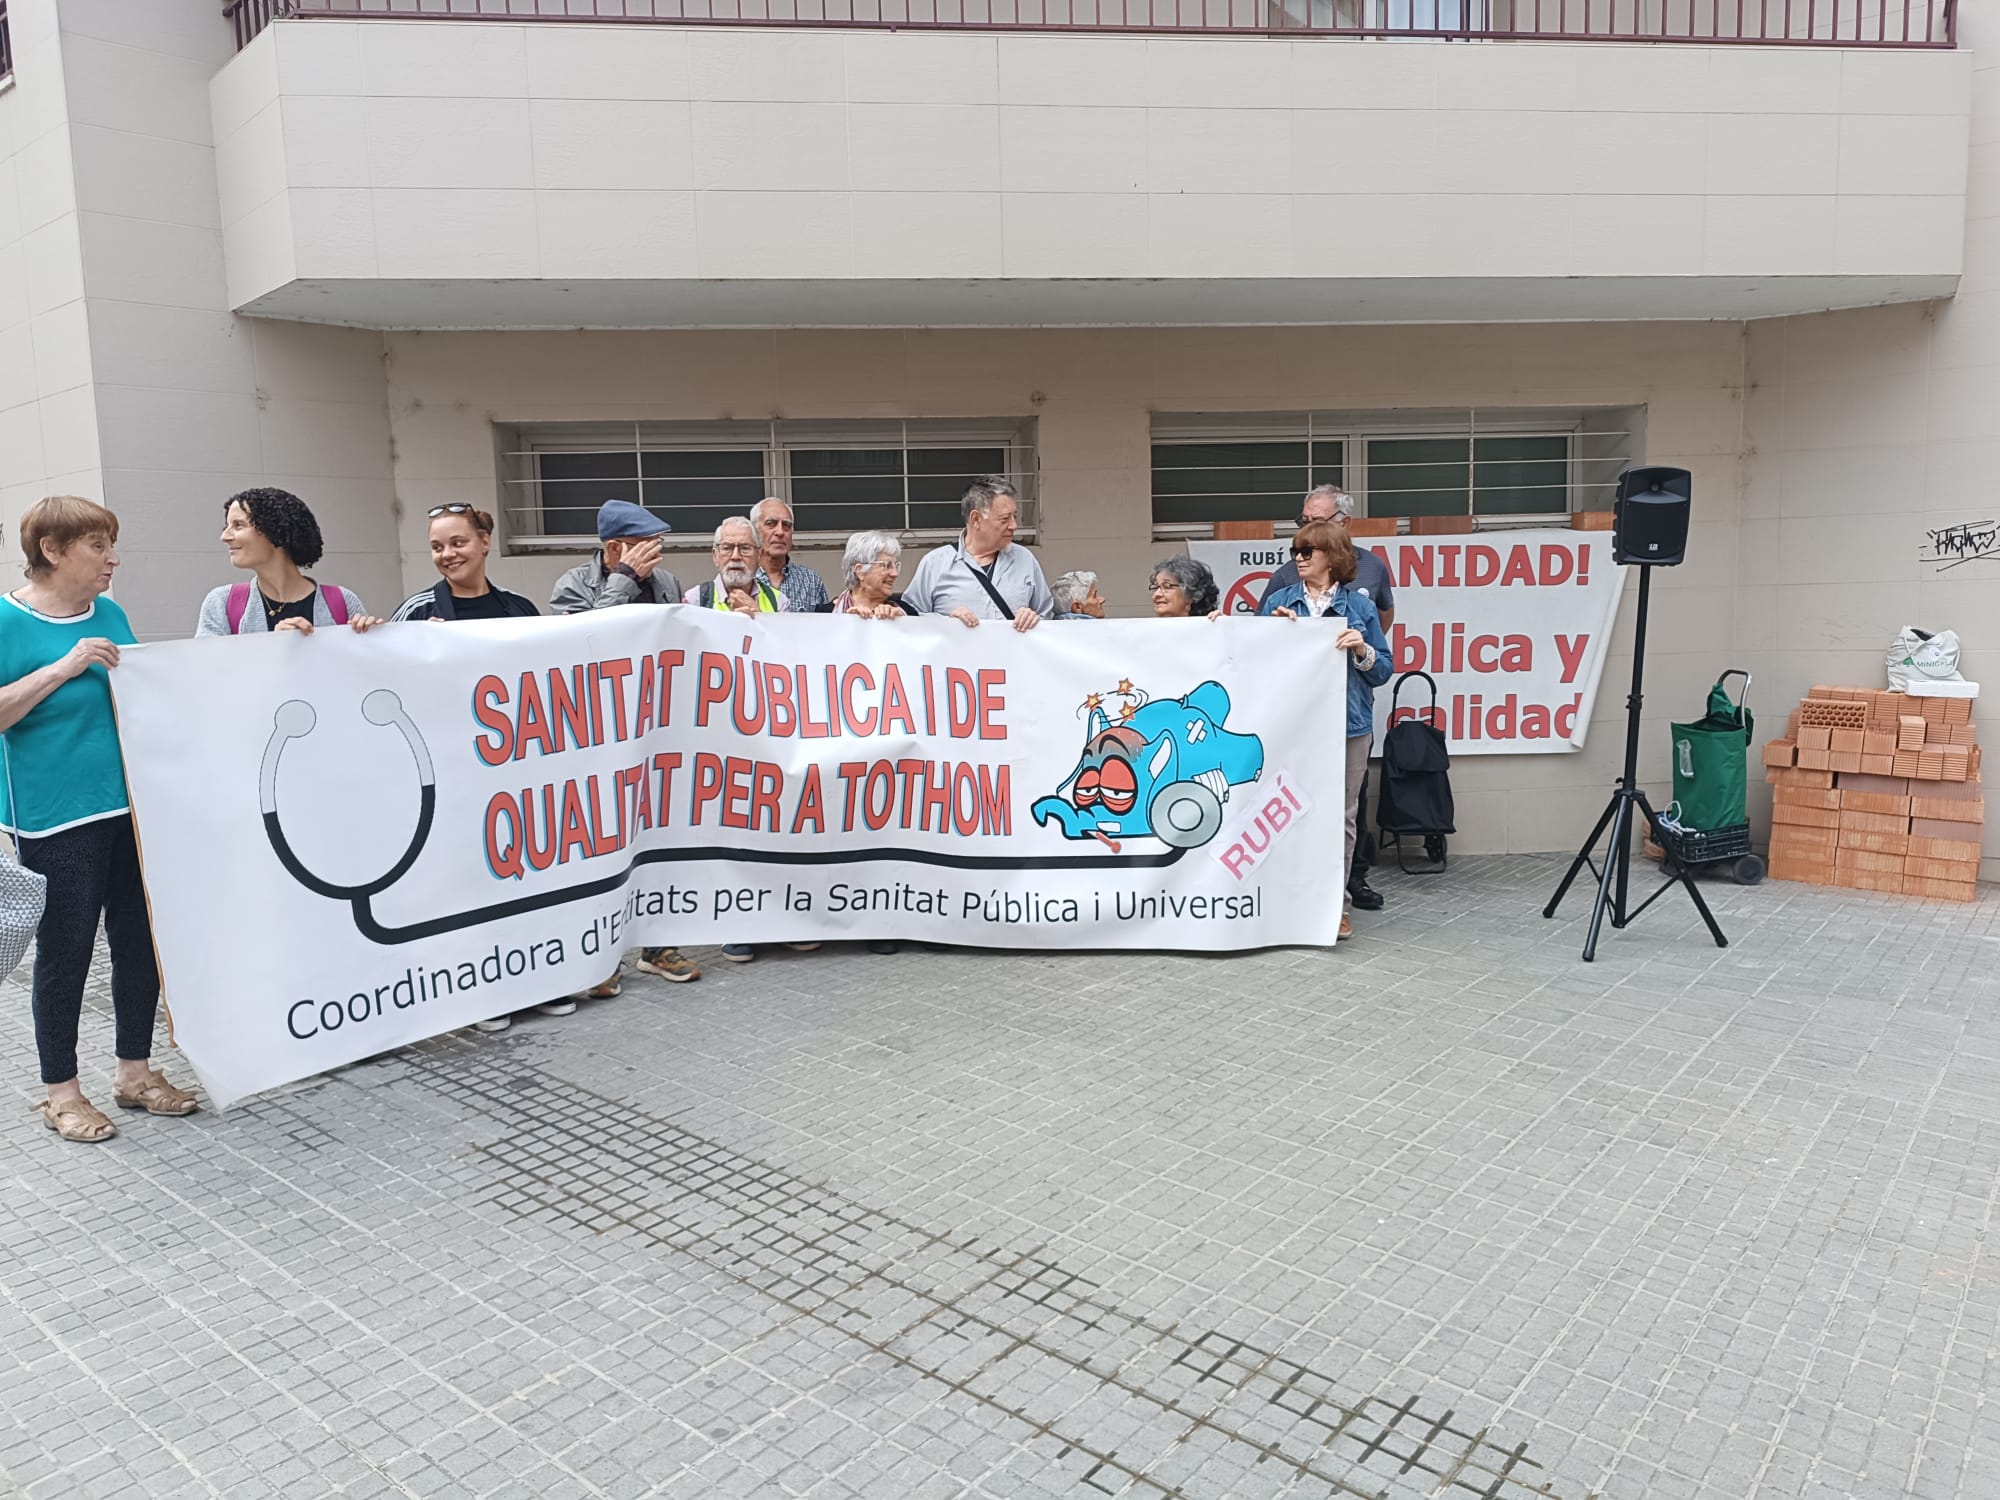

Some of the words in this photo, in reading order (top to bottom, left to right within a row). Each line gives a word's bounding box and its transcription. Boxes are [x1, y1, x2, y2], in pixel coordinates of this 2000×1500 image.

[1239, 547, 1284, 565] RUBÍ
[1371, 543, 1591, 587] NIDAD!
[473, 650, 685, 766] SANITAT
[696, 635, 916, 738] PÚBLICA
[920, 664, 937, 736] I
[946, 667, 1008, 740] DE
[1392, 623, 1532, 674] blica
[1553, 634, 1590, 683] y
[483, 752, 683, 880] QUALITAT
[689, 752, 784, 833] PER
[791, 763, 825, 833] A
[838, 759, 1012, 836] TOTHOM
[1219, 774, 1303, 880] RUBÍ
[287, 938, 565, 1040] Coordinadora
[714, 887, 772, 920] per
[785, 883, 812, 912] la
[827, 882, 949, 916] Sanitat
[962, 889, 1078, 924] Pública
[1094, 893, 1100, 921] i
[1115, 886, 1261, 921] Universal
